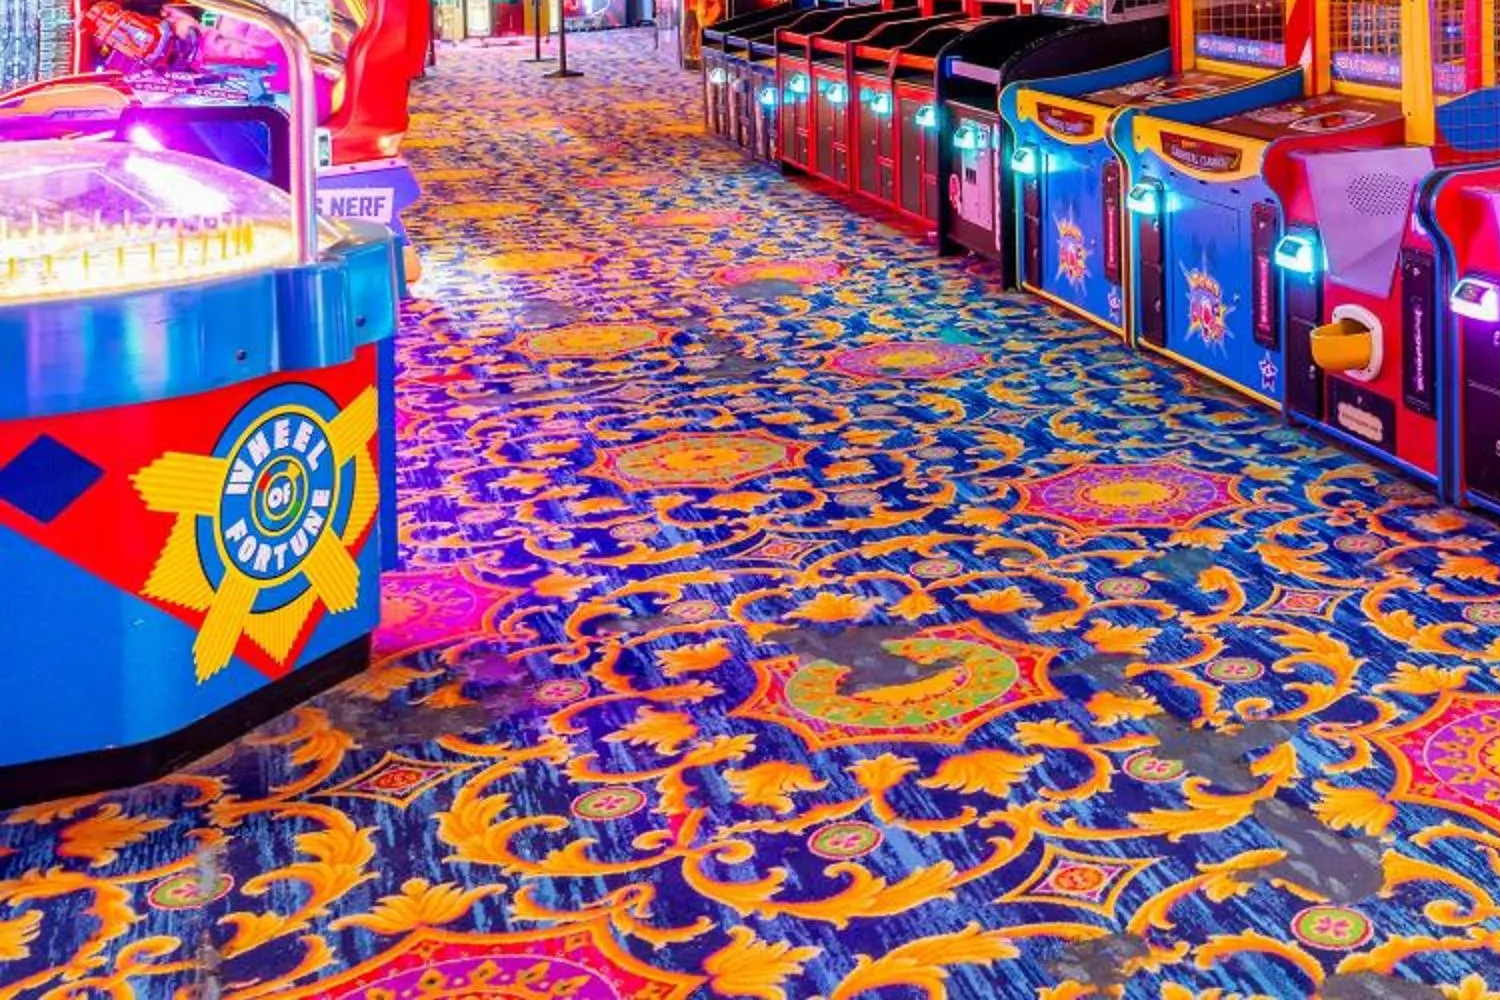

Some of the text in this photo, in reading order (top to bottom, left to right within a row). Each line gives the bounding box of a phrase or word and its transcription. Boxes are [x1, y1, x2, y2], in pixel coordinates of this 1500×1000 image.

[330, 196, 386, 216] NERF
[225, 417, 328, 495] WHEEL
[267, 482, 291, 509] OF
[224, 489, 331, 573] FORTUNE
